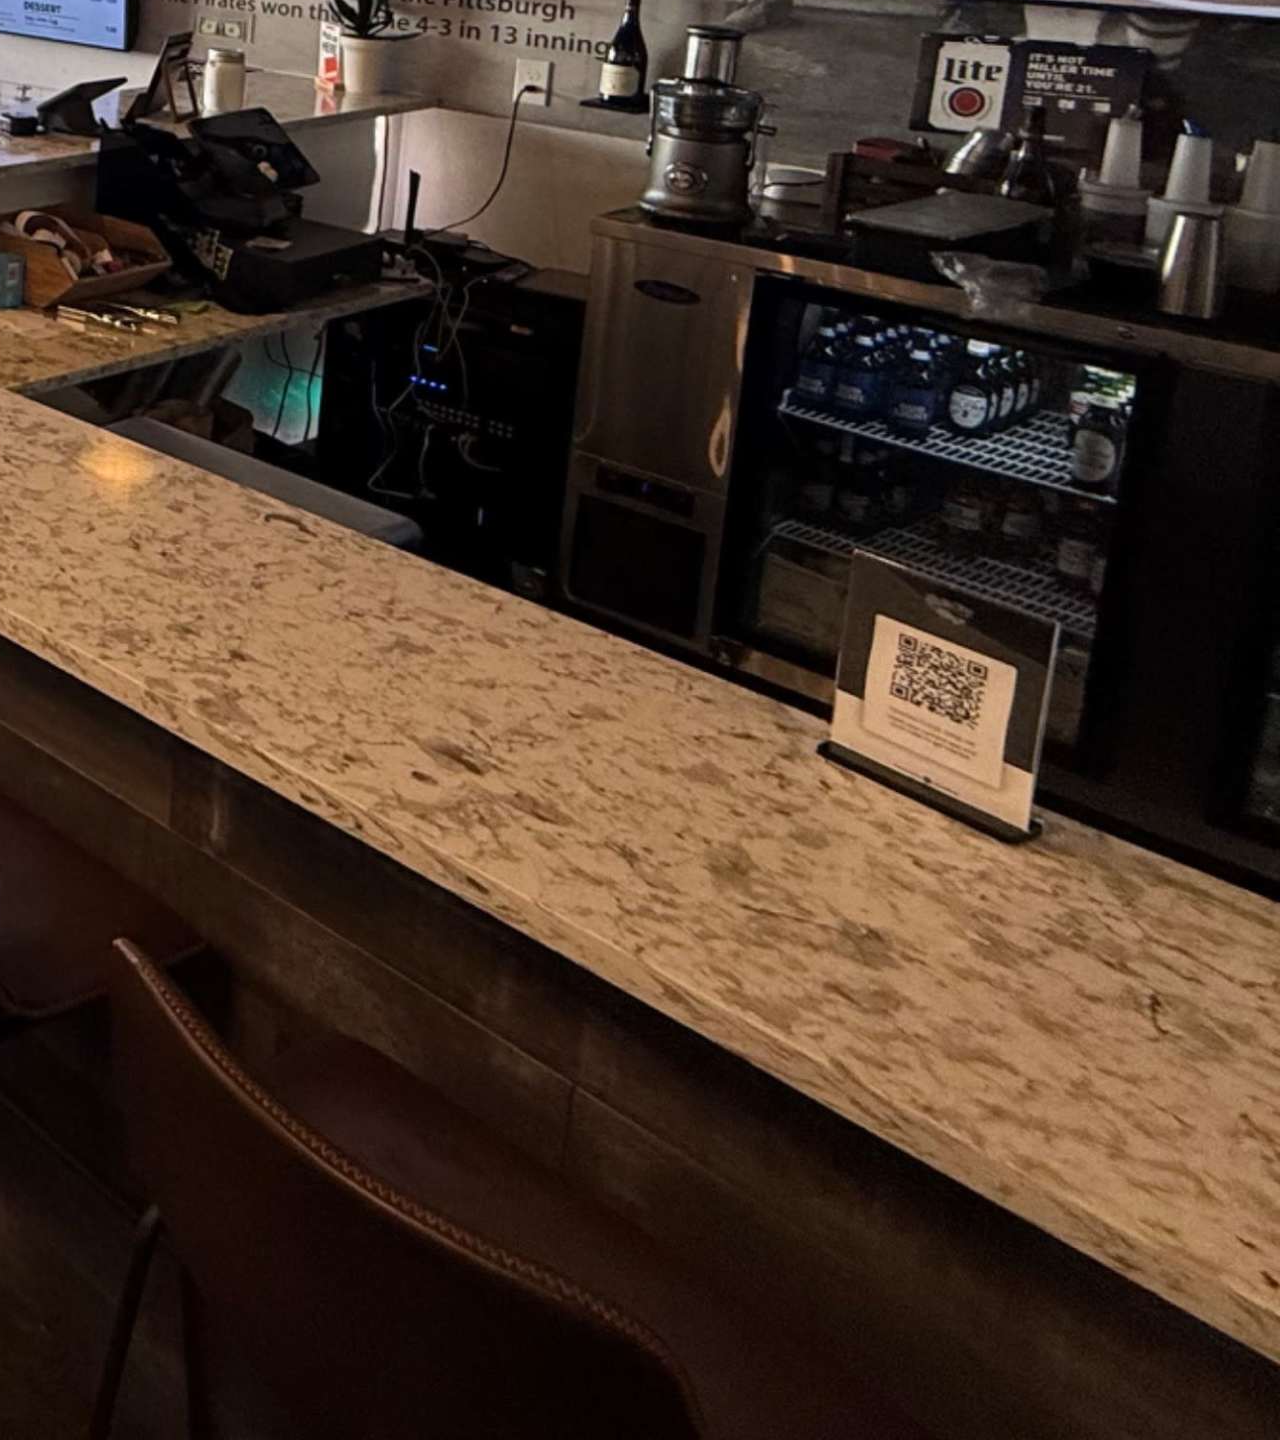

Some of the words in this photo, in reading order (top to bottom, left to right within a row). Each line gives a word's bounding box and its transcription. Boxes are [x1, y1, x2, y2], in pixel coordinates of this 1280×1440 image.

[23, 0, 62, 14] DESSERT
[261, 2, 303, 19] won
[415, 16, 452, 34] 4-3
[458, 20, 482, 40] in
[490, 25, 518, 45] 13
[1029, 53, 1055, 64] IT'S
[1057, 55, 1085, 65] NOT
[944, 56, 1003, 83] Lite
[1027, 71, 1064, 82] UNTIL
[1028, 62, 1078, 74] MILLER
[1081, 66, 1117, 78] TIME
[1025, 80, 1071, 92] YOU'RE
[1074, 84, 1097, 94] 21.
